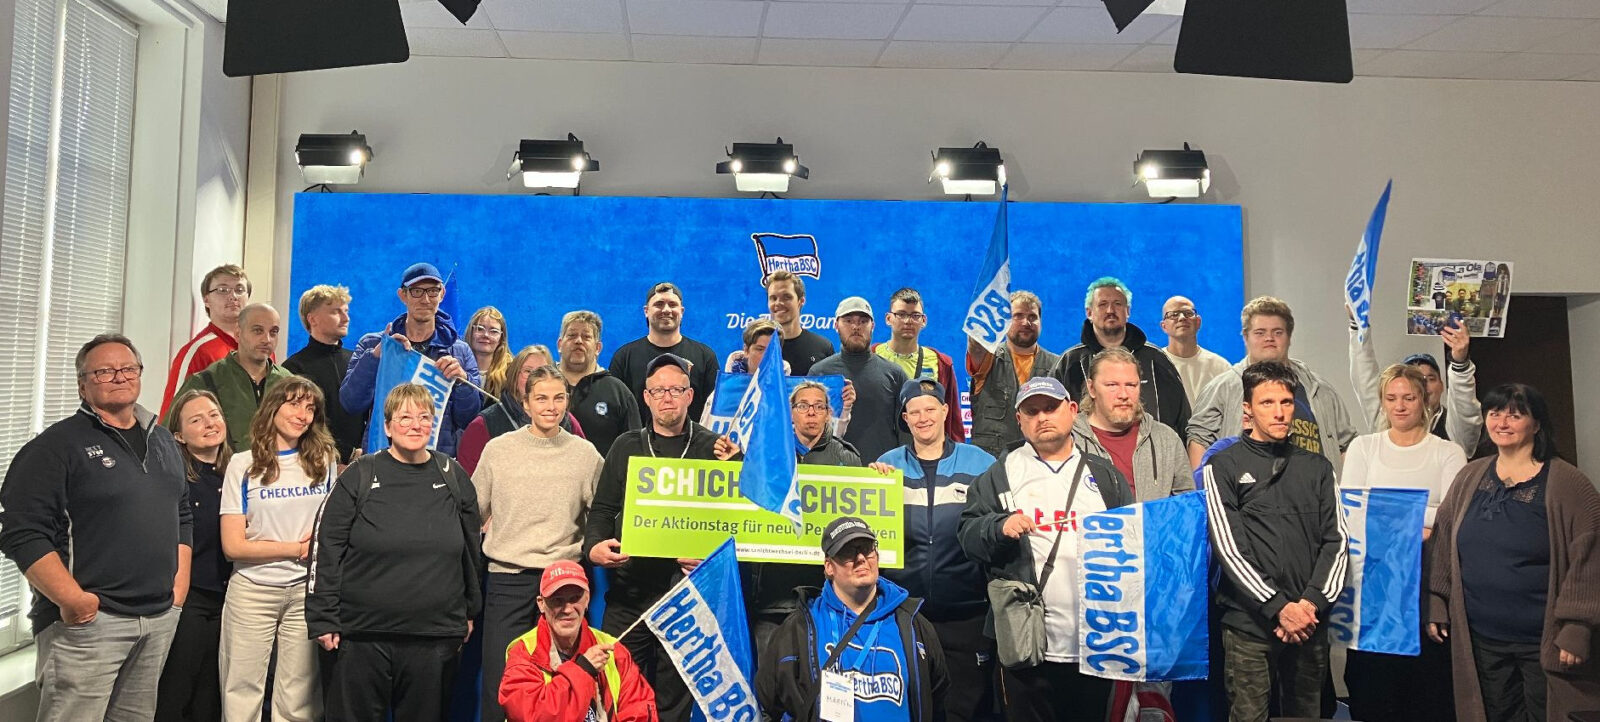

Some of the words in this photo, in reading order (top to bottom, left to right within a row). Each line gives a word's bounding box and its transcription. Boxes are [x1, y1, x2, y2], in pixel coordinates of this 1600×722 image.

[636, 466, 744, 498] SCHICH
[801, 484, 896, 517] CHSEL
[634, 515, 657, 528] Der
[661, 516, 740, 535] Aktionstag
[743, 520, 763, 533] für
[651, 587, 723, 697] Hertha
[1086, 608, 1141, 674] BSC
